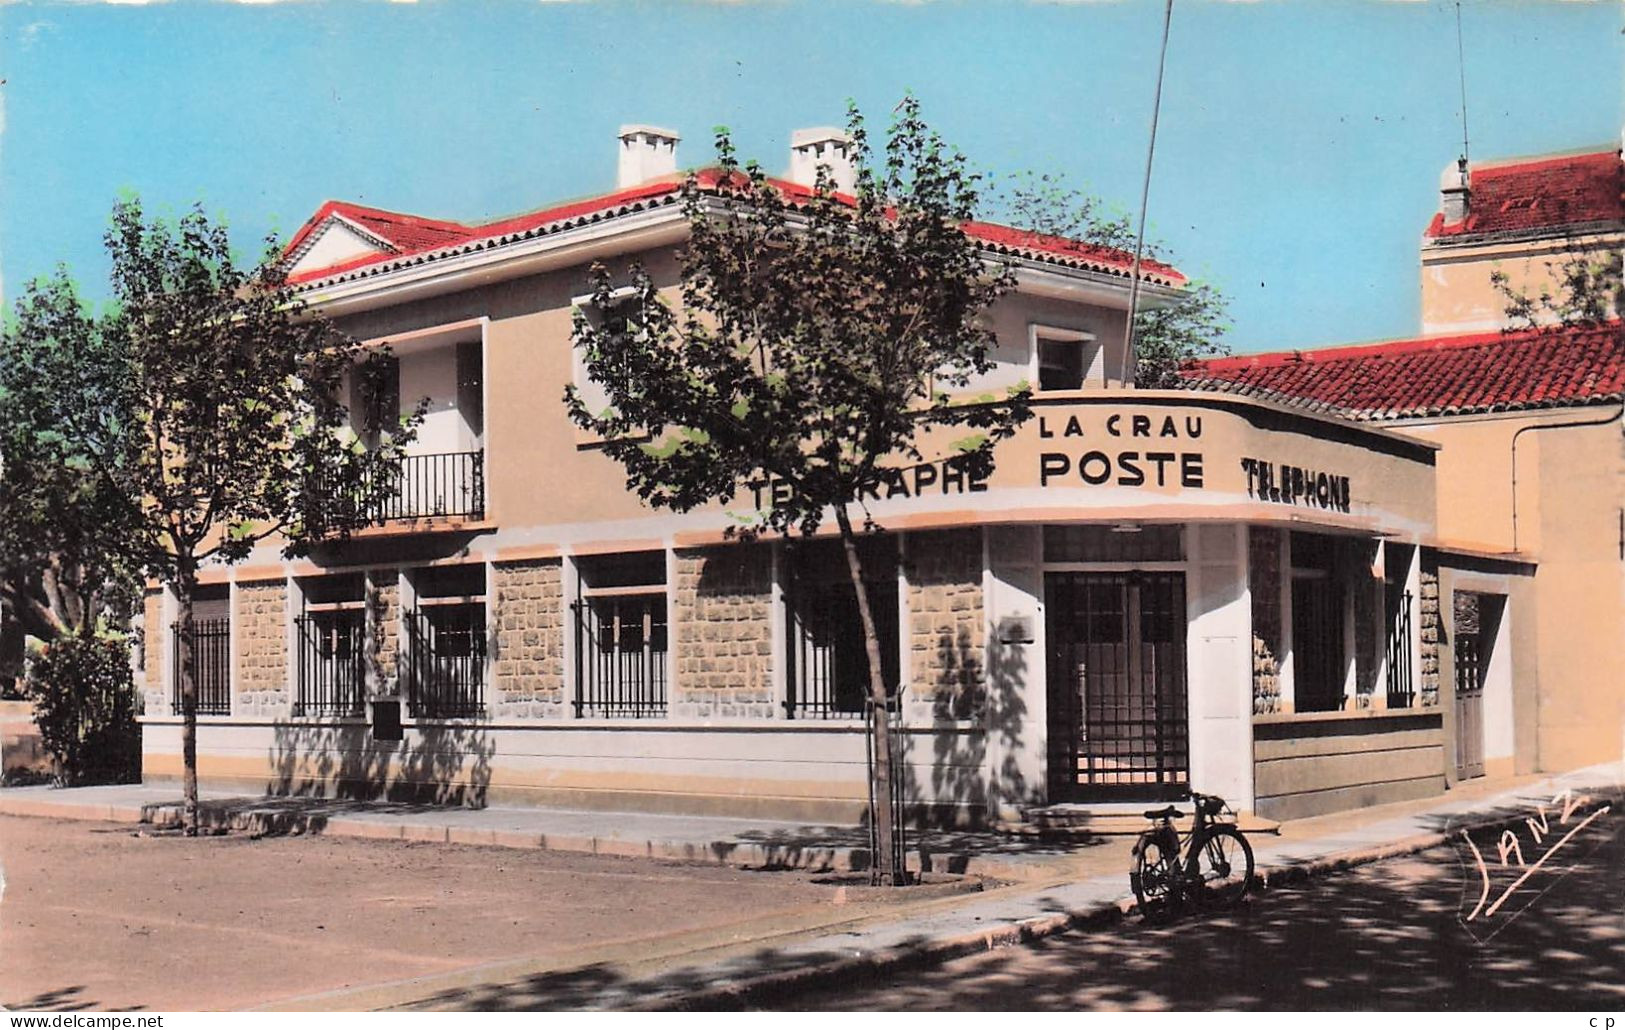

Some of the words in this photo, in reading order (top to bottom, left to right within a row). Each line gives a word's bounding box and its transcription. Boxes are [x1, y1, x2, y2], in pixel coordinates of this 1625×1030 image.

[1039, 415, 1084, 438] LA
[1106, 414, 1202, 439] CRAU
[1040, 450, 1204, 489] POSTE
[1240, 457, 1350, 514] TELEPHONE
